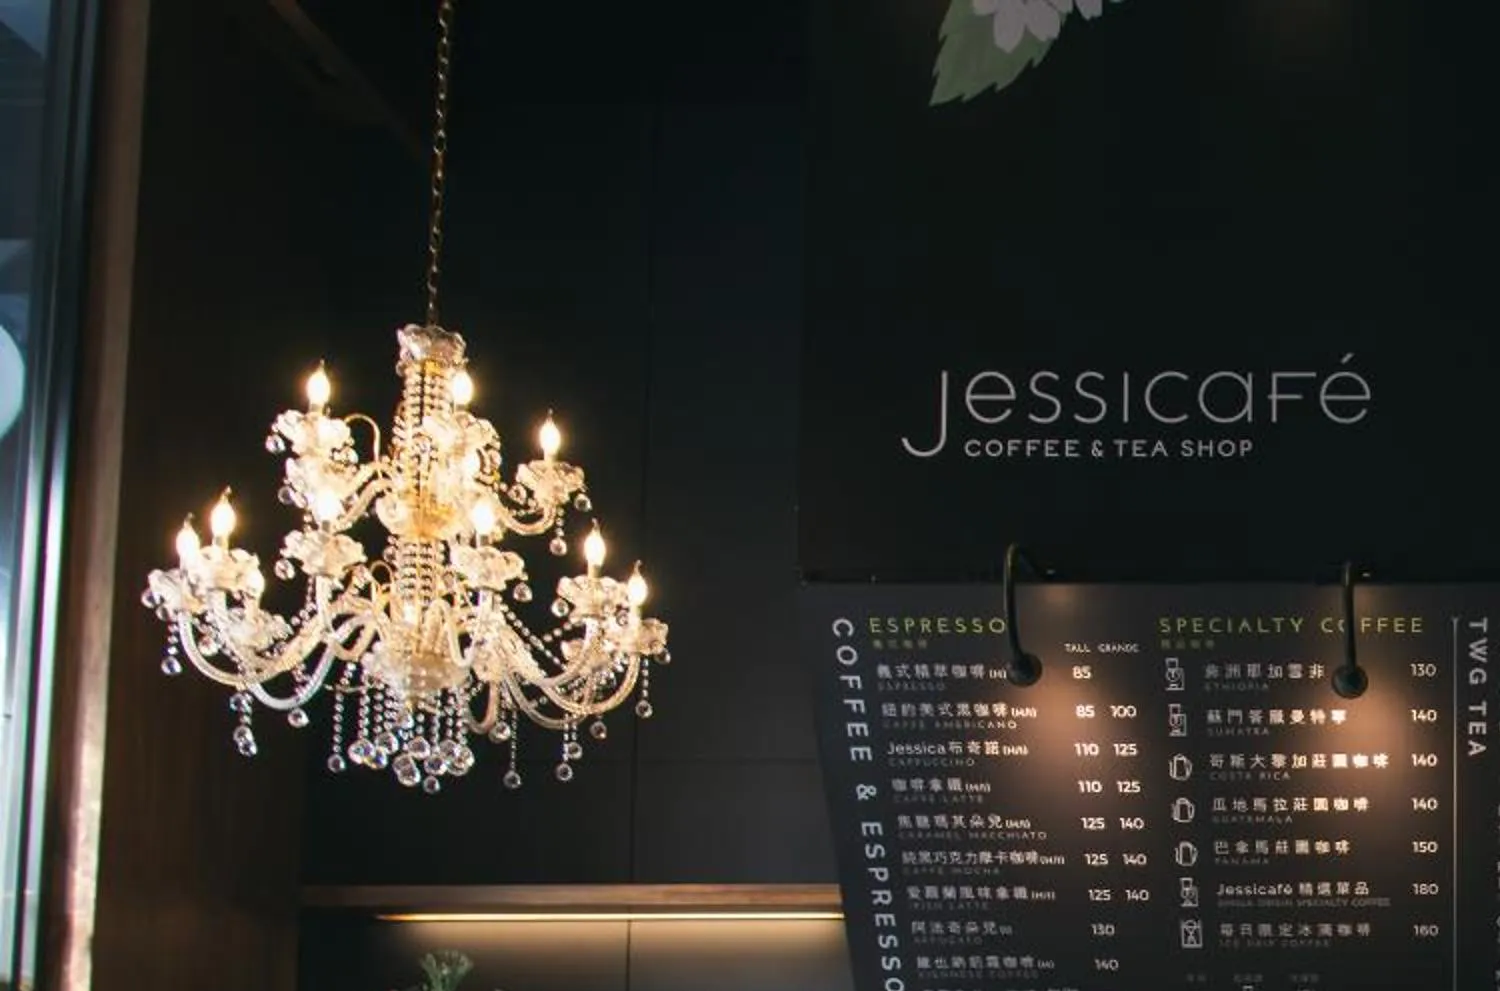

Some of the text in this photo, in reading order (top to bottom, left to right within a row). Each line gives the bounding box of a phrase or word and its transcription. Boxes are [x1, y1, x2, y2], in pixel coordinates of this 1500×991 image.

[964, 439, 1253, 457] COFFEE & TEA SHOP
[869, 617, 1005, 634] ESPRESSO
[1159, 617, 1304, 633] SPECIALTY
[1064, 643, 1091, 653] TALL
[1073, 666, 1091, 679] 85
[1410, 664, 1436, 677] 130
[1468, 617, 1488, 756] TWG TEA
[832, 618, 873, 762] COFFEE
[856, 783, 876, 802] &
[1076, 705, 1094, 717] 85
[1110, 705, 1136, 717] 100
[1412, 709, 1436, 722] 140
[1074, 743, 1099, 756] 110
[1114, 743, 1137, 756] 125
[1412, 753, 1437, 767] 140
[1078, 781, 1102, 793] 110
[1117, 781, 1140, 793] 125
[1412, 798, 1438, 811] 140
[1081, 818, 1144, 830] 125 140
[1412, 841, 1438, 853] 150
[1084, 853, 1108, 866] 125
[1123, 853, 1147, 866] 140
[1088, 889, 1149, 901] 125 140
[1412, 883, 1438, 895] 180
[1091, 924, 1115, 936] 130
[1413, 924, 1438, 936] 160
[1095, 958, 1118, 971] 140
